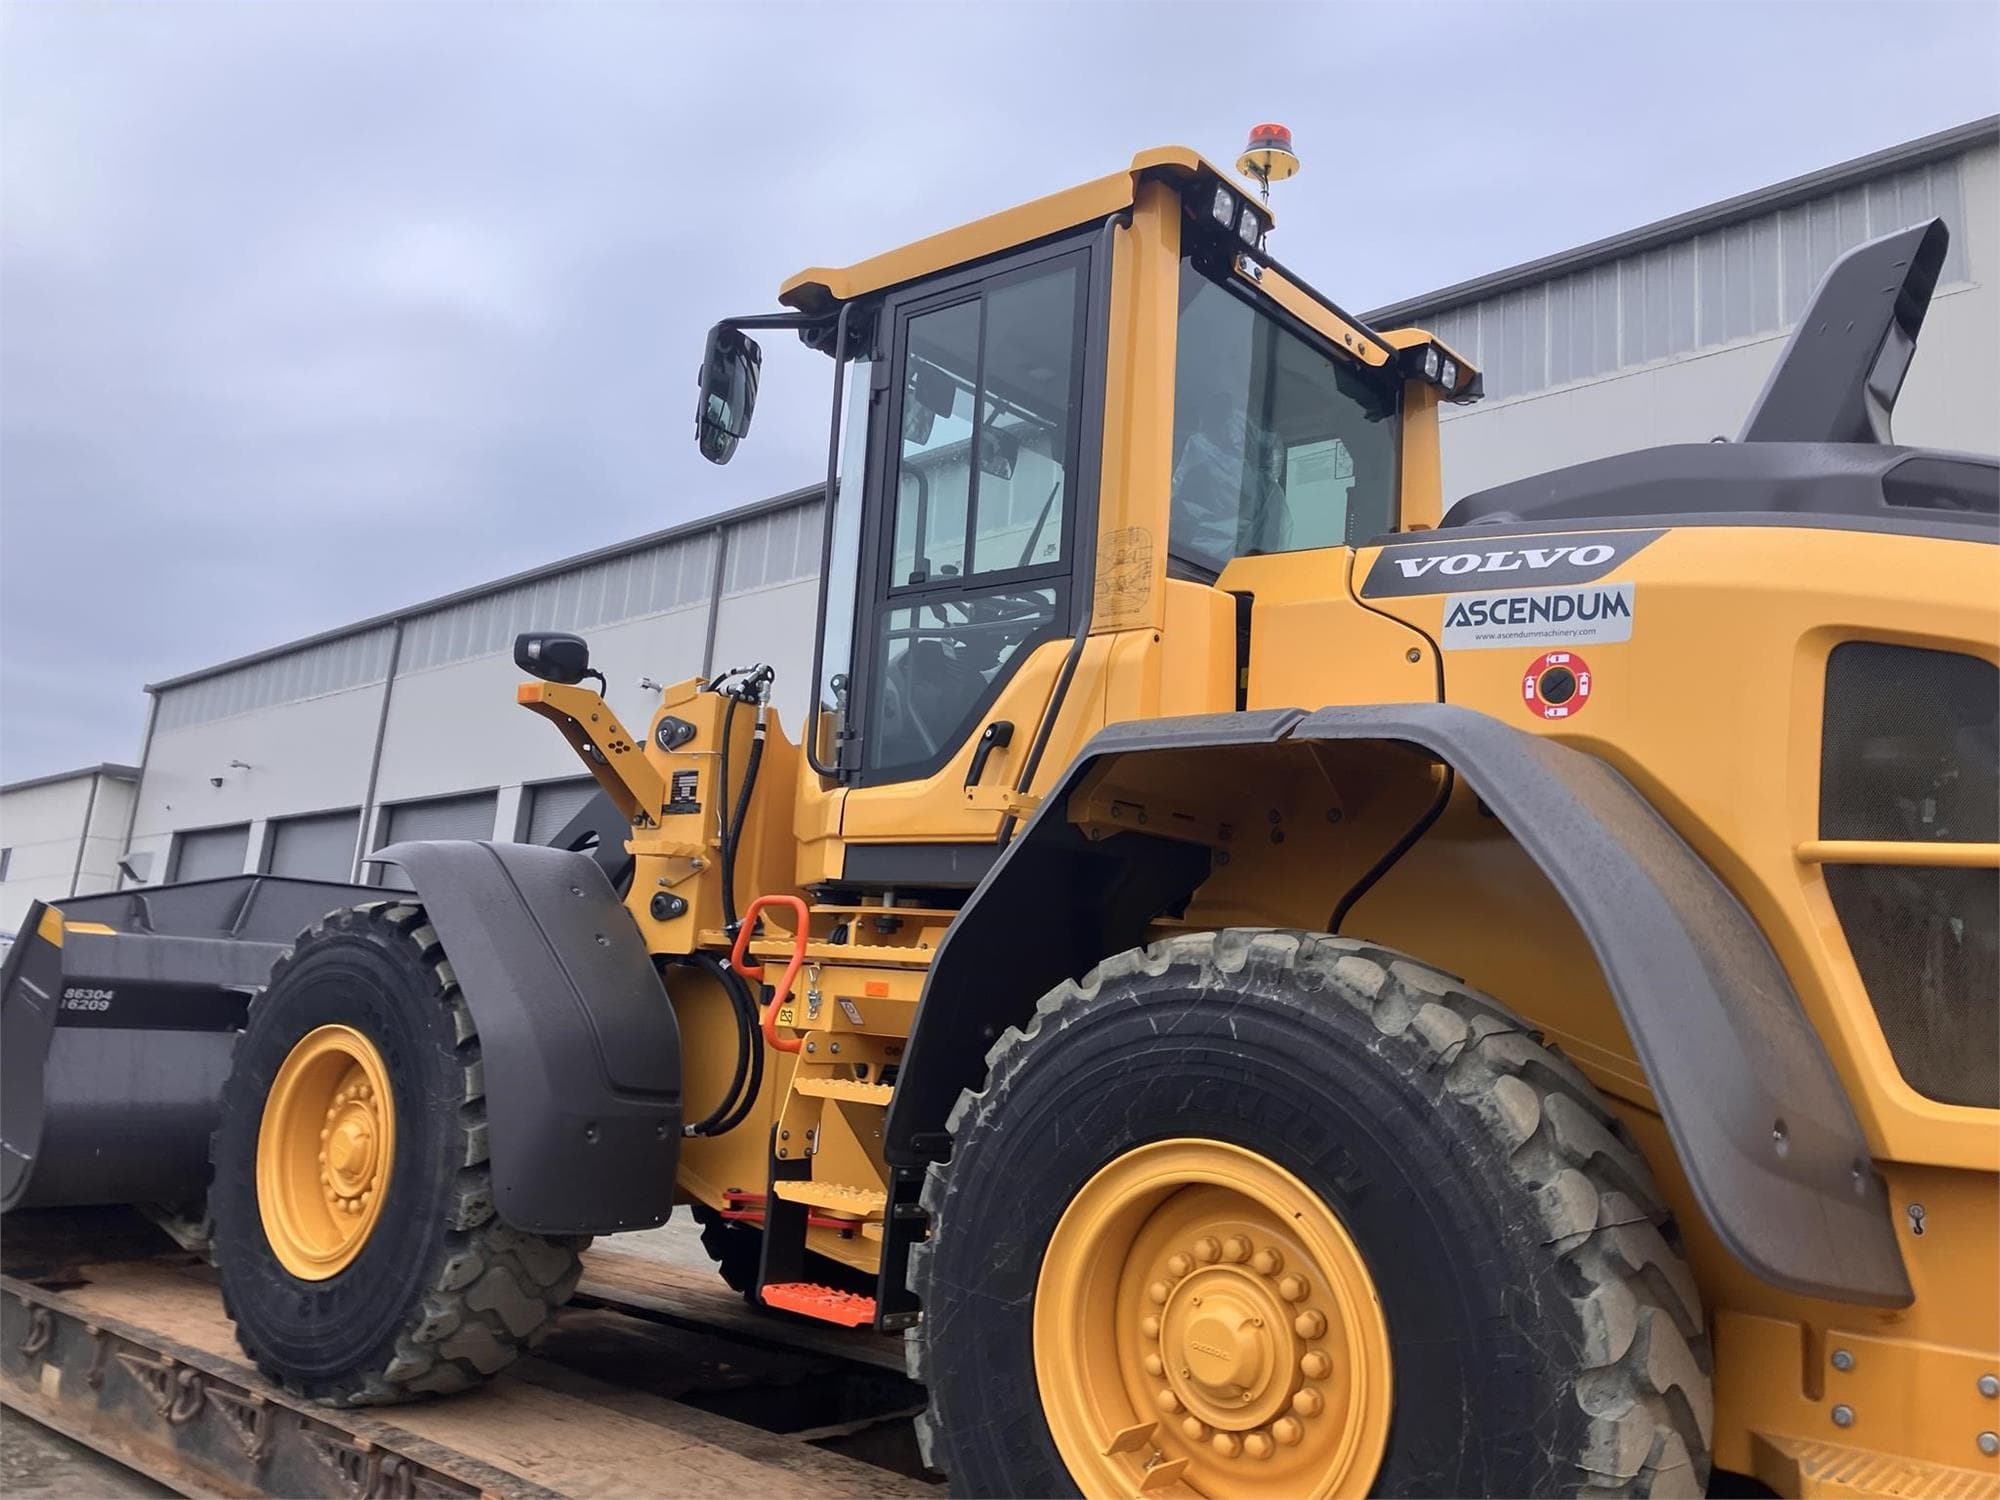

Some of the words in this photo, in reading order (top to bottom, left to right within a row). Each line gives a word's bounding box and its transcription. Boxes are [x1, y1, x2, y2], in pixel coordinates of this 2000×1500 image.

[1395, 546, 1615, 578] VOLVO
[1445, 591, 1631, 628] ASCENDUM
[1475, 628, 1597, 641] www.ascendummachinery.com
